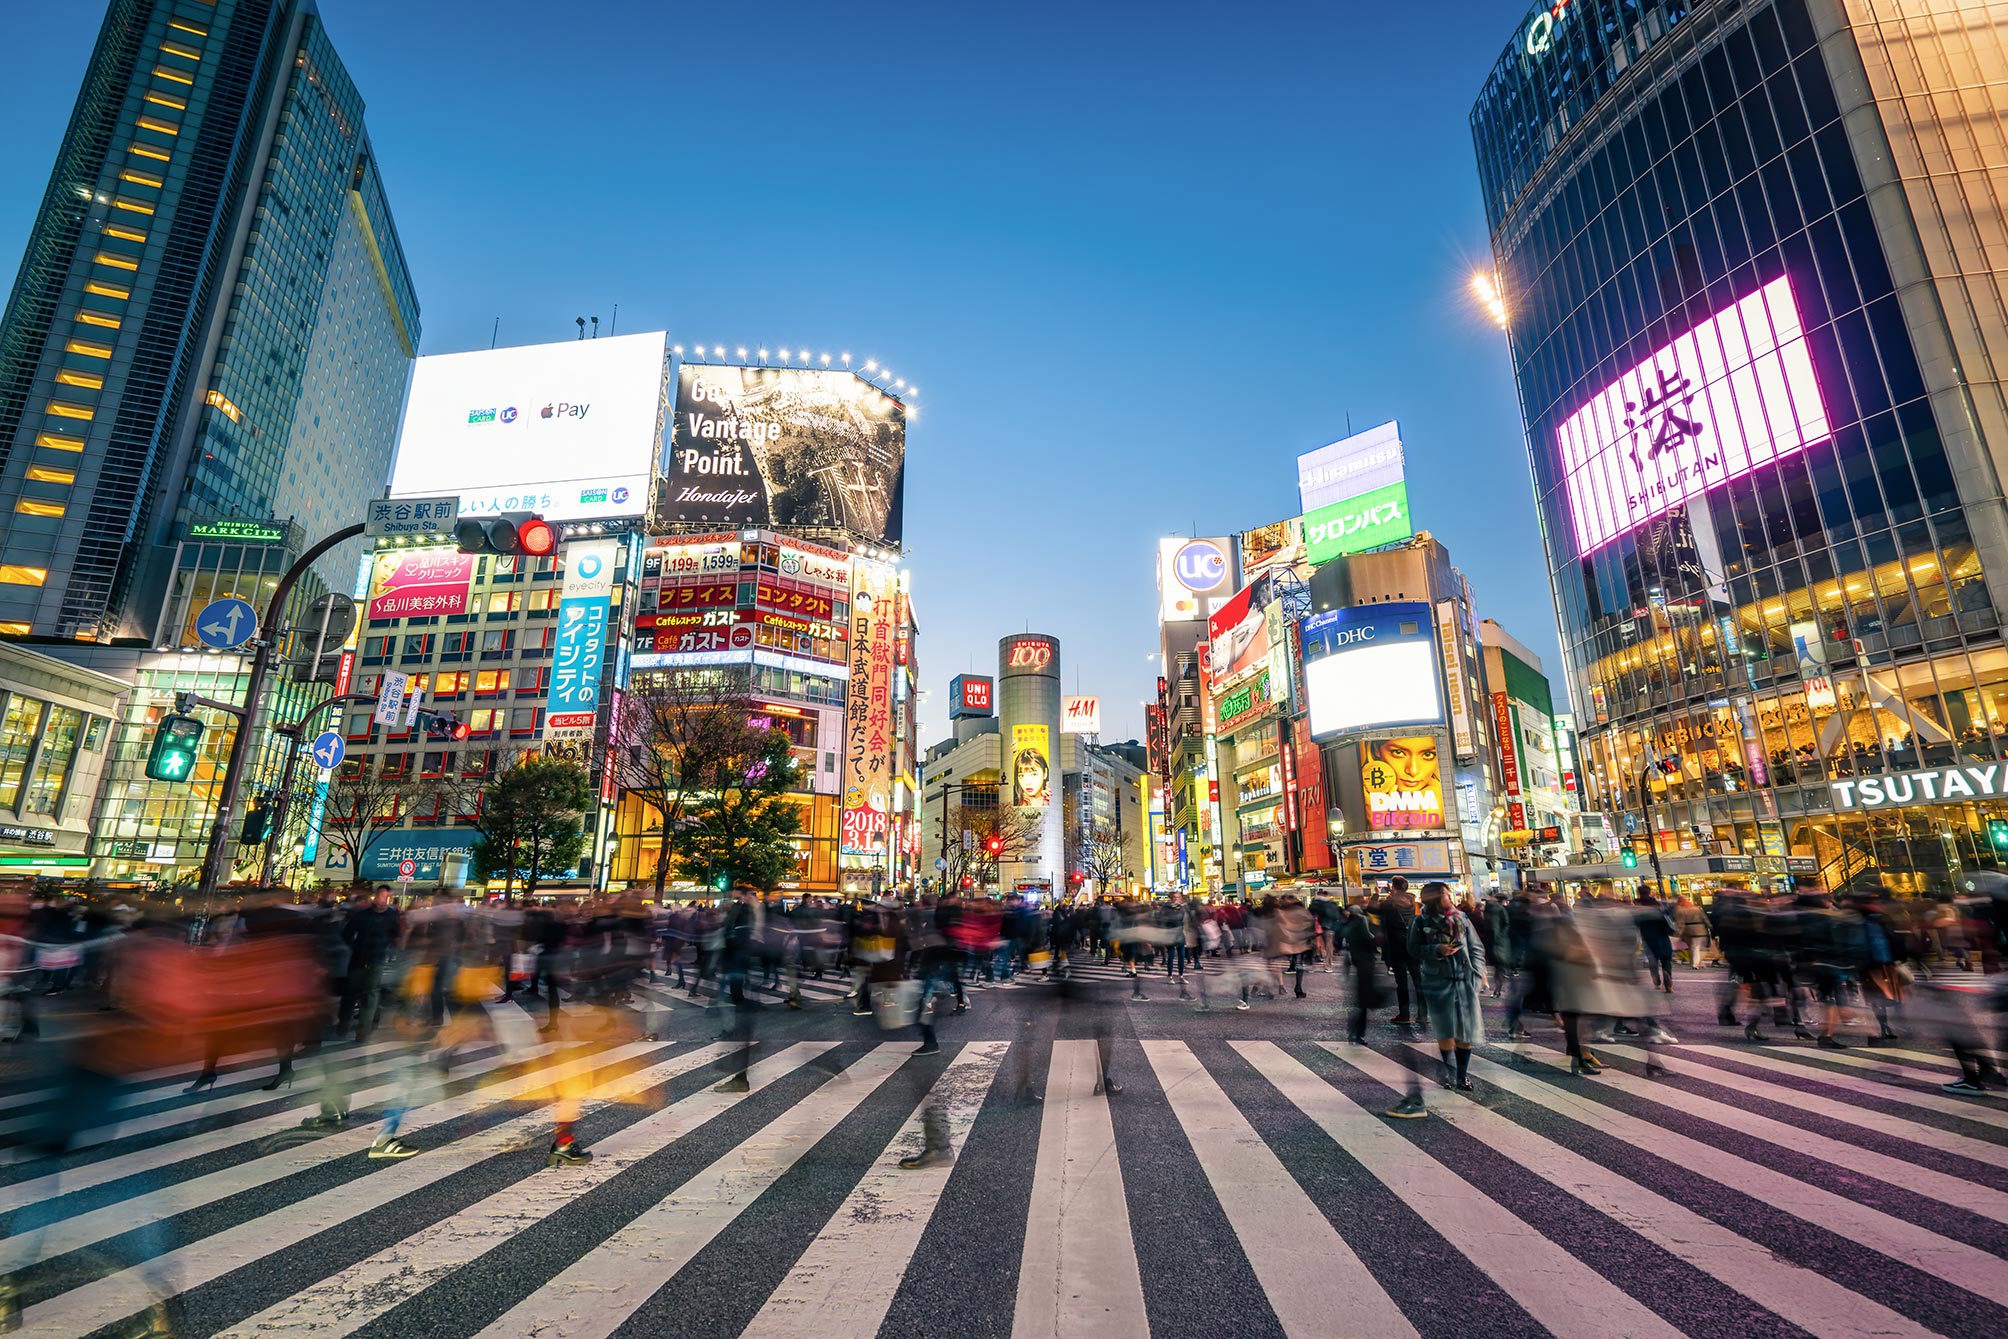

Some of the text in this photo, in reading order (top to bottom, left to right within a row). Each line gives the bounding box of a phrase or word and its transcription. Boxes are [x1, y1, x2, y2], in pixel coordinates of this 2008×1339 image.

[557, 402, 590, 419] Pay
[689, 413, 780, 446] Vantage
[1624, 369, 1703, 473] 渋
[684, 449, 749, 476] Point.
[1629, 452, 1719, 510] SHIBUTAN
[581, 488, 608, 497] SAISON
[583, 495, 603, 503] CARD
[675, 485, 758, 509] HondaJet
[374, 502, 452, 521] 渋谷駅前
[193, 525, 281, 537] MARK CITY
[217, 521, 259, 529] SHIBUYA
[384, 521, 440, 532] Shibuya Sta.
[1309, 501, 1402, 544] サロンパス
[419, 555, 469, 568] 品川スキン
[646, 558, 660, 568] 9F
[664, 557, 699, 574] 1,199円
[702, 554, 738, 571] 1,599円
[418, 567, 462, 580] クリニック
[804, 560, 848, 583] しゃぶ葉
[569, 581, 606, 591] eyecity
[661, 586, 734, 605] プライス
[383, 594, 462, 612] 品川美容外科
[758, 586, 830, 614] コンタクト
[703, 611, 741, 626] ガスト
[1305, 615, 1338, 632] DHC Channel
[808, 620, 842, 640] ガスト
[1337, 626, 1375, 646] DHC
[636, 637, 654, 649] 7F
[657, 635, 678, 645] Café
[679, 631, 726, 651] ガスト
[556, 607, 585, 703] アイシティ
[578, 606, 603, 702] コンタクトの
[1009, 646, 1051, 671] 109
[1441, 617, 1462, 716] Taisei neon
[868, 596, 891, 773] 打首獄門同好会が
[967, 683, 986, 695] UNI
[384, 676, 404, 722] 渋谷駅前
[849, 617, 871, 783] 日本武道館だって。
[967, 694, 987, 706] QLO
[1068, 700, 1095, 718] H&M
[555, 716, 590, 725] 当ビル5階
[1496, 694, 1512, 750] クスリのことなら
[1504, 754, 1519, 790] 三千里
[1832, 764, 2008, 808] TSUTAY
[1369, 789, 1439, 811] DMM
[844, 810, 886, 833] 2018
[1371, 811, 1440, 827] Bitcoin
[848, 830, 876, 850] 3.1
